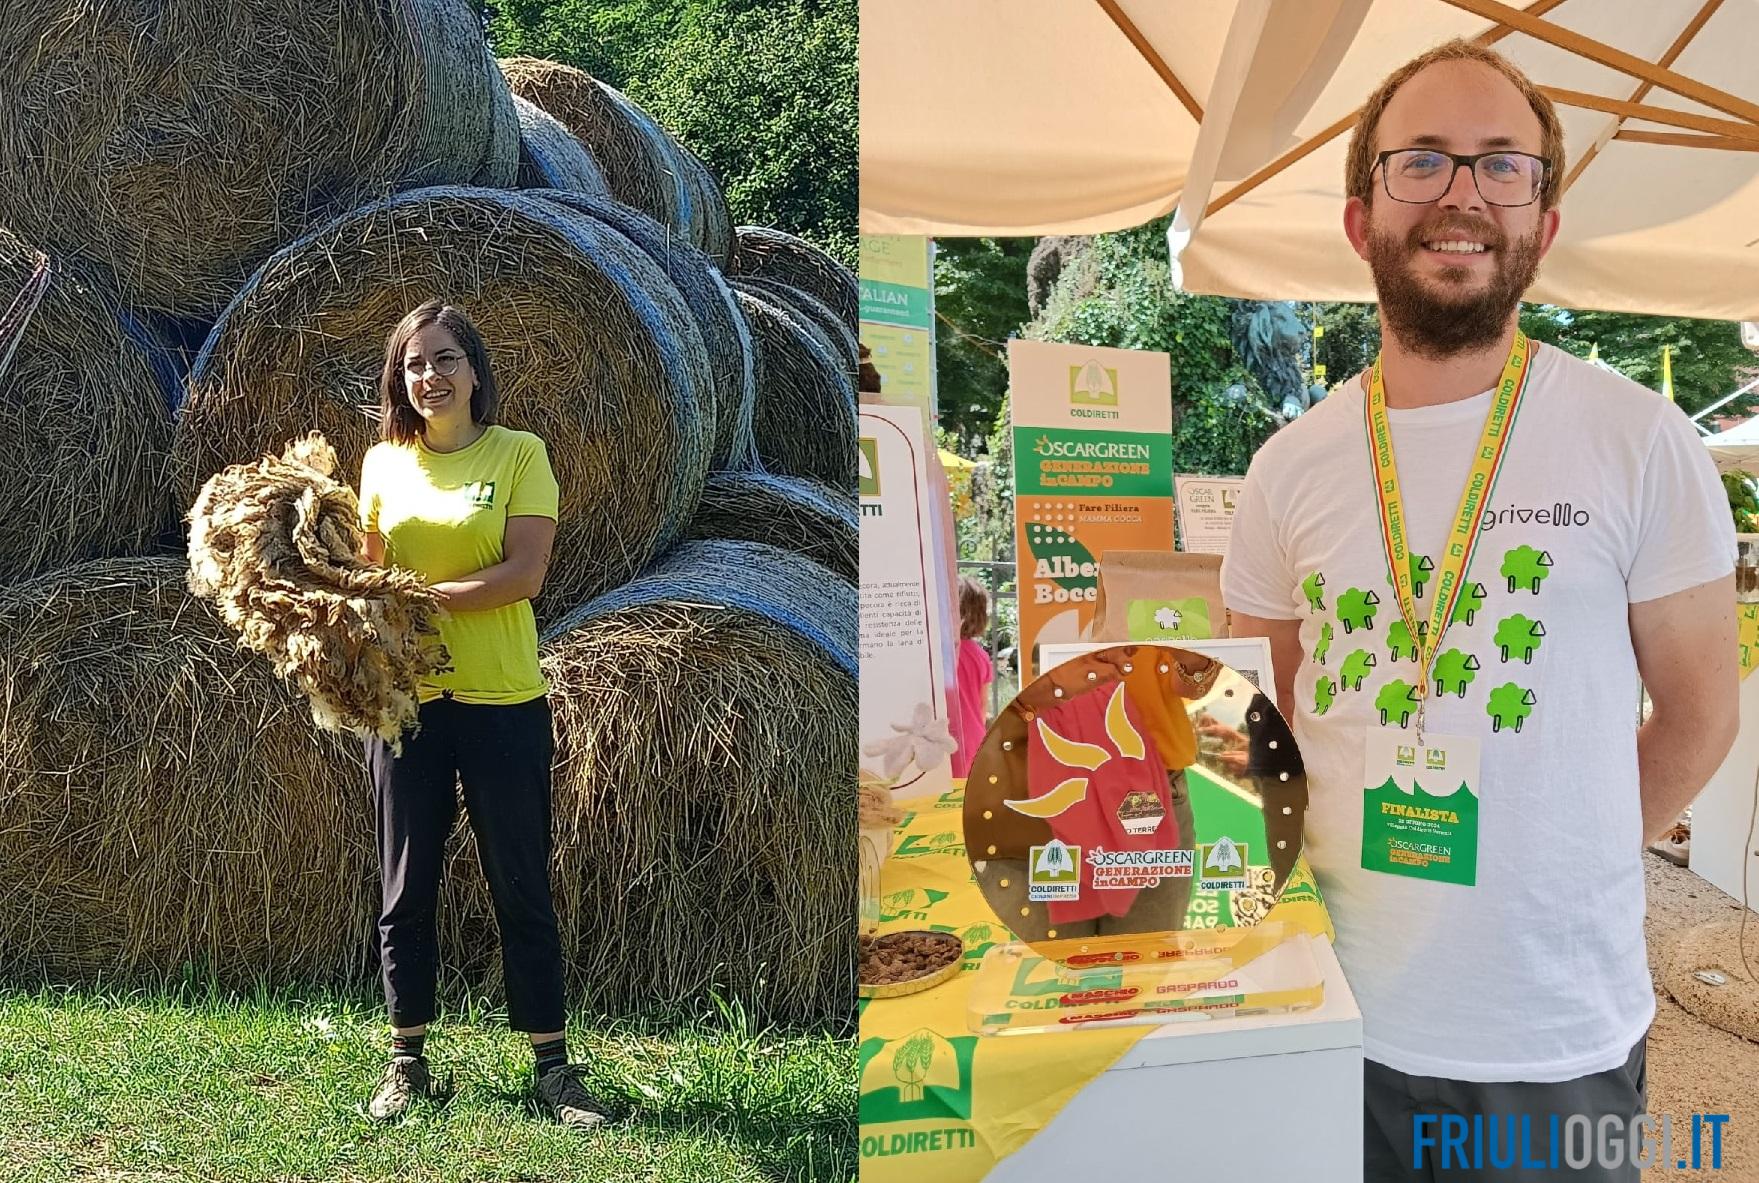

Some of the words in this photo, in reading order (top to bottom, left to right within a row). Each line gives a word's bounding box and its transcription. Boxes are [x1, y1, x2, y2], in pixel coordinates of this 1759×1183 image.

[1070, 408, 1119, 419] COLDIRETTI
[1488, 378, 1515, 437] COLDIRETTI
[1374, 411, 1390, 468] COLDIRETTI
[1037, 439, 1150, 459] OSCARGREEN
[1456, 472, 1486, 535] COLDIRETTI
[1387, 500, 1405, 561] COLDIRETTI
[1431, 570, 1455, 637] COLDIRETTI
[1381, 802, 1459, 824] FINALISTA
[1389, 840, 1452, 856] OSCARGREEN
[1091, 850, 1193, 865] OSCARGREEN
[1095, 865, 1192, 877] GENERAZIONE
[1030, 885, 1077, 893] COLDIRETTI
[1201, 881, 1246, 890] COLDIRETTI
[1156, 979, 1239, 994] GASPARDO
